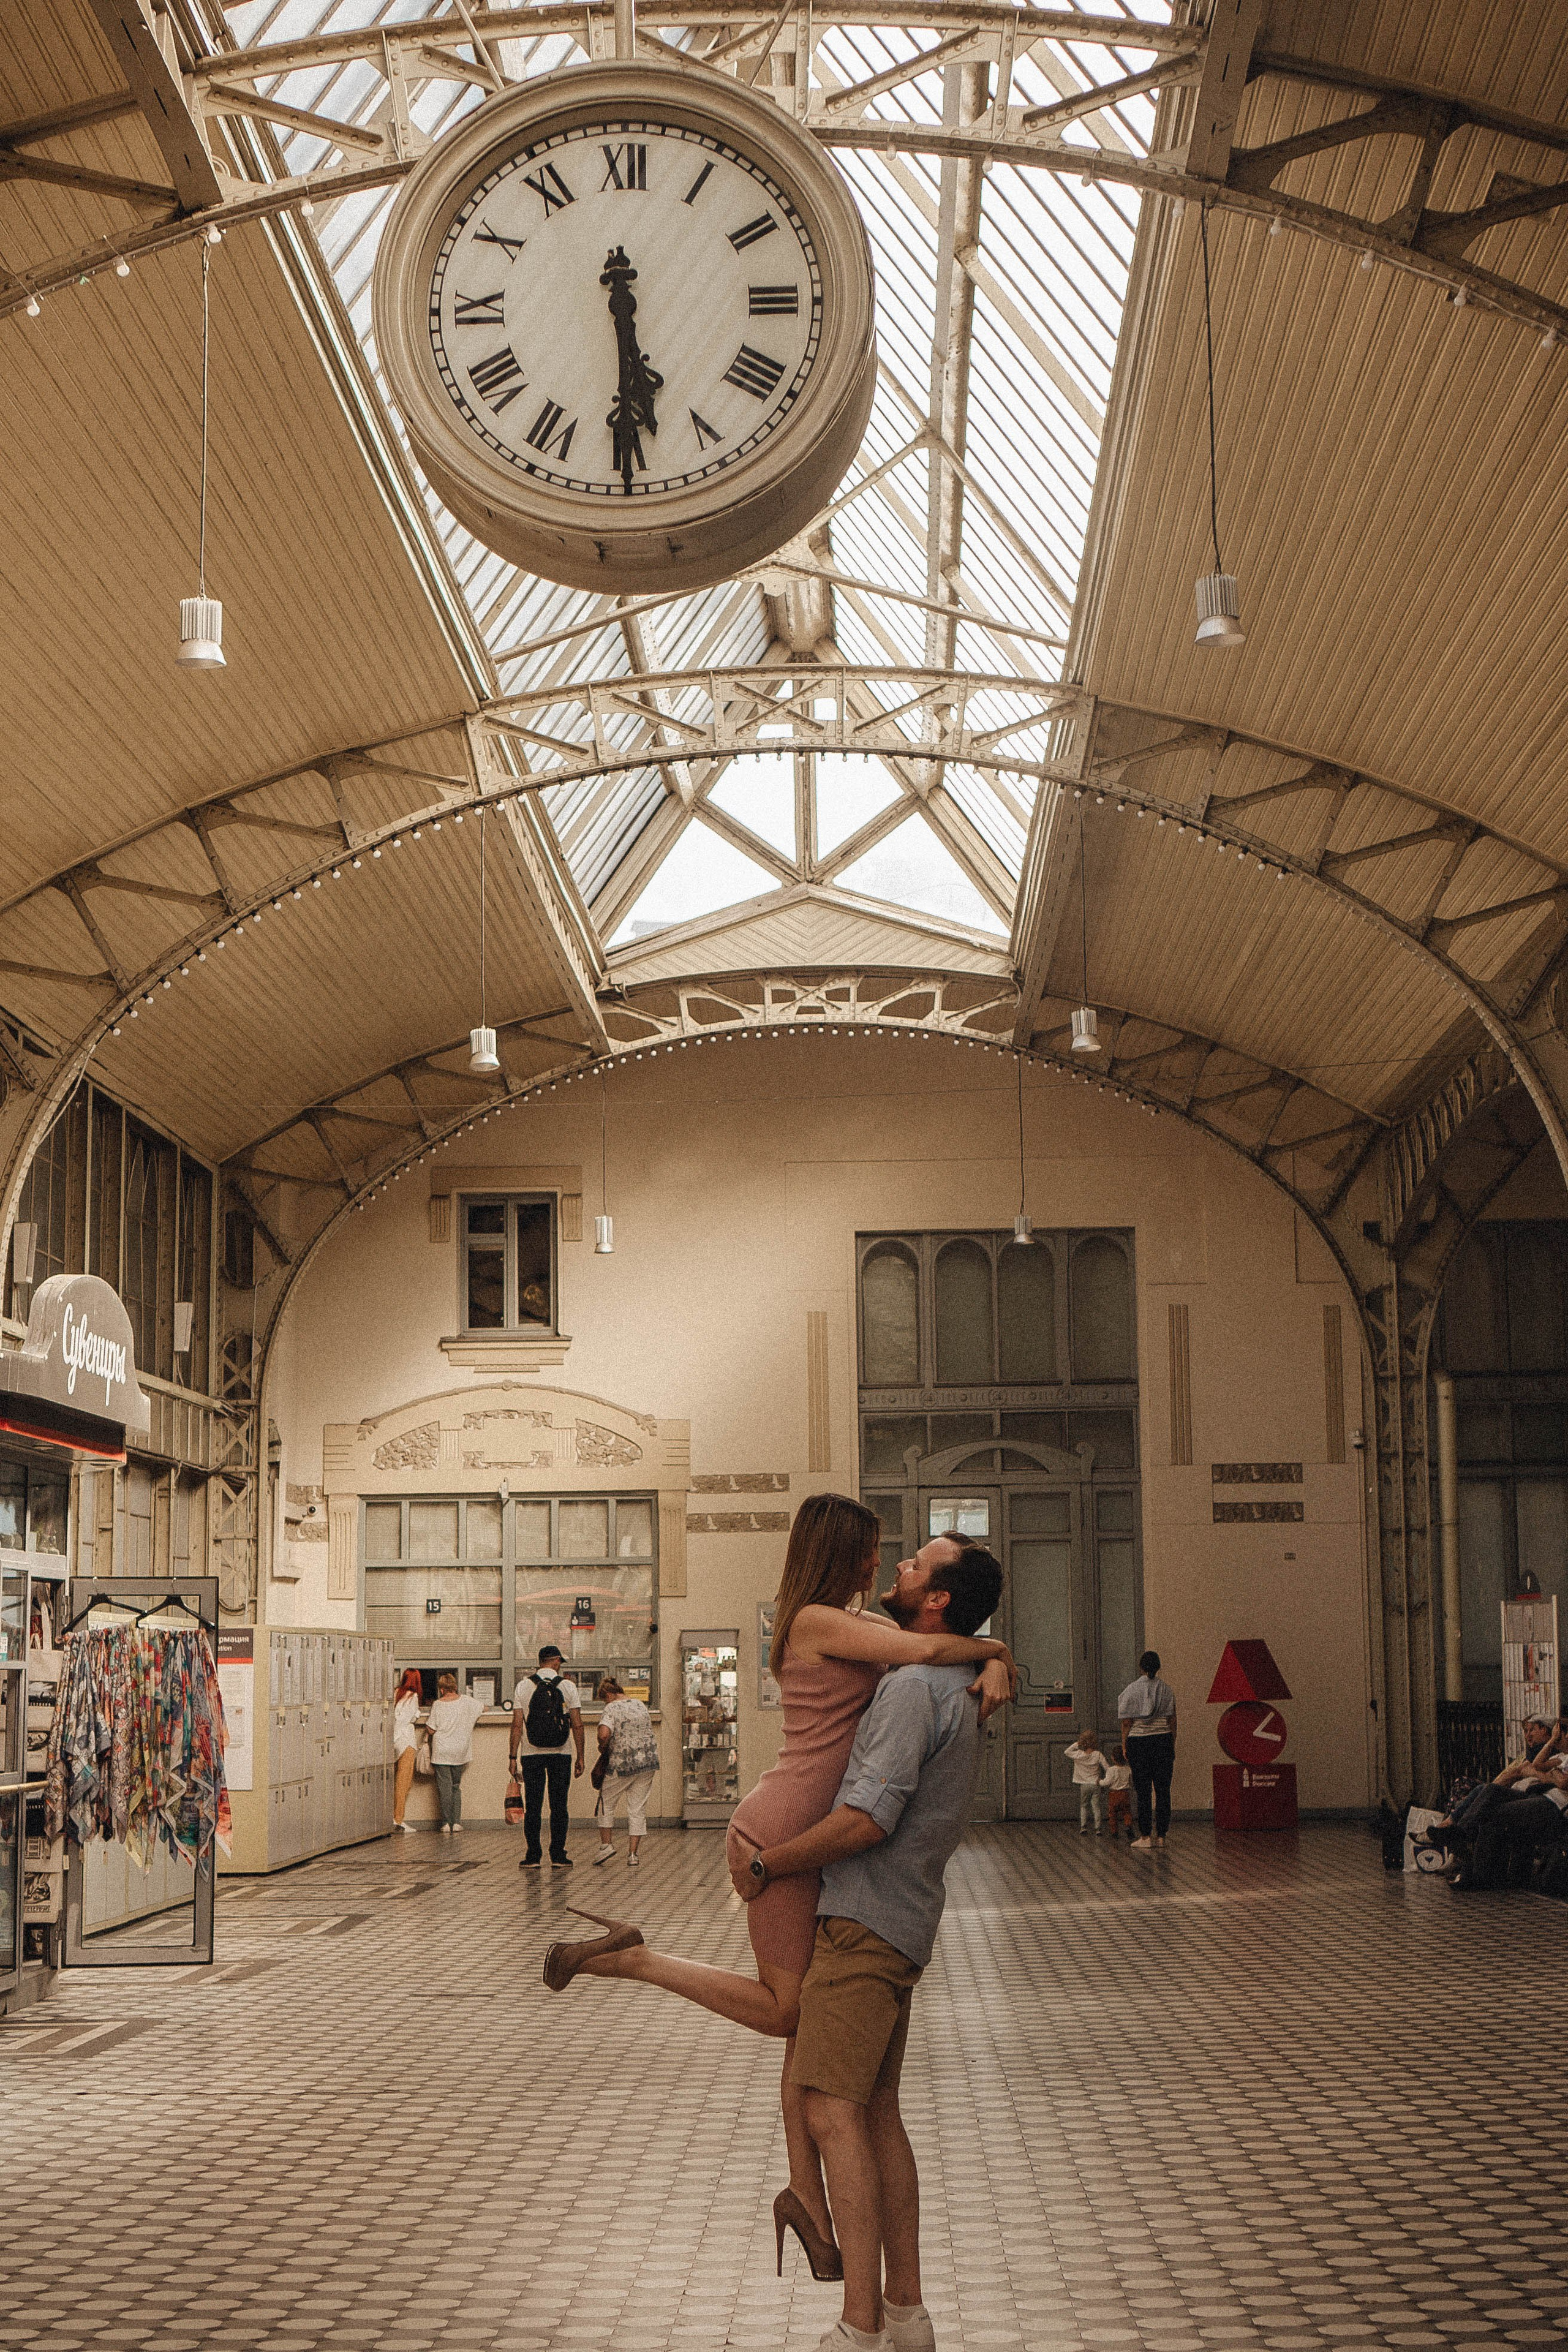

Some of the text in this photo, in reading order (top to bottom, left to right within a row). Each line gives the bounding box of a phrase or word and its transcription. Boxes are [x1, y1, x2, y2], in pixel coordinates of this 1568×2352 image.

[519, 161, 579, 220] XI
[599, 143, 649, 192] XII
[680, 160, 718, 206] I
[471, 217, 527, 263] X
[726, 209, 780, 255] II
[454, 288, 505, 329] IX
[748, 283, 799, 318] III
[467, 343, 530, 417] VIII
[720, 342, 787, 404] IIII
[522, 398, 579, 462] VII
[689, 407, 726, 452] V
[62, 1302, 126, 1406] Сувениры
[428, 1601, 439, 1611] 15
[578, 1599, 589, 1609] 16
